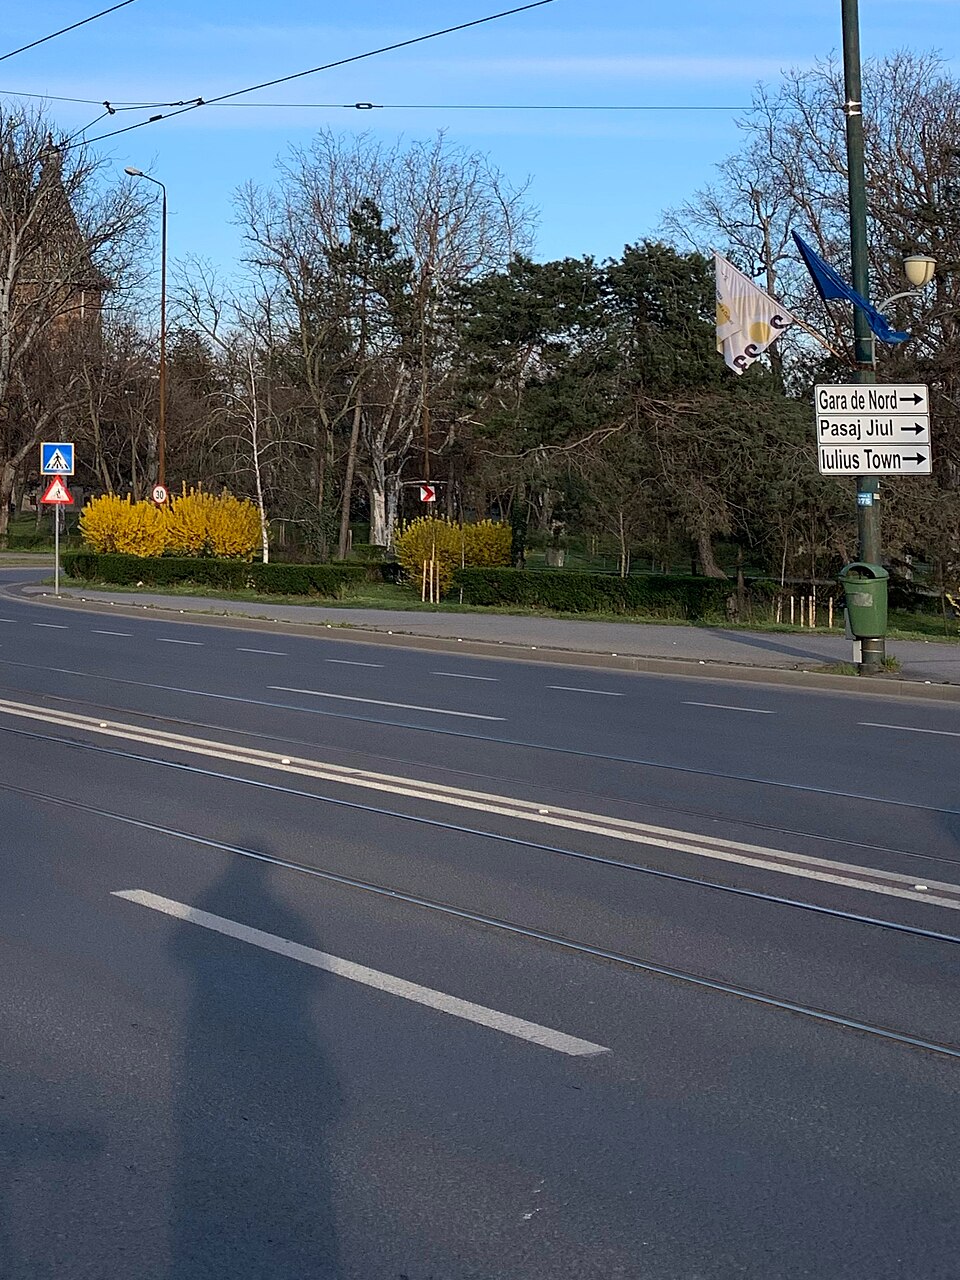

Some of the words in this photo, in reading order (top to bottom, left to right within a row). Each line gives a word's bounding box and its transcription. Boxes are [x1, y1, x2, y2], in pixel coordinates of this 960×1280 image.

[819, 389, 847, 410] Gara
[850, 389, 865, 410] de
[868, 389, 898, 410] Nord
[820, 419, 861, 440] Pasaj
[866, 419, 893, 436] Jiul
[821, 449, 860, 469] Iulius
[863, 449, 901, 469] Town
[156, 490, 164, 499] 30
